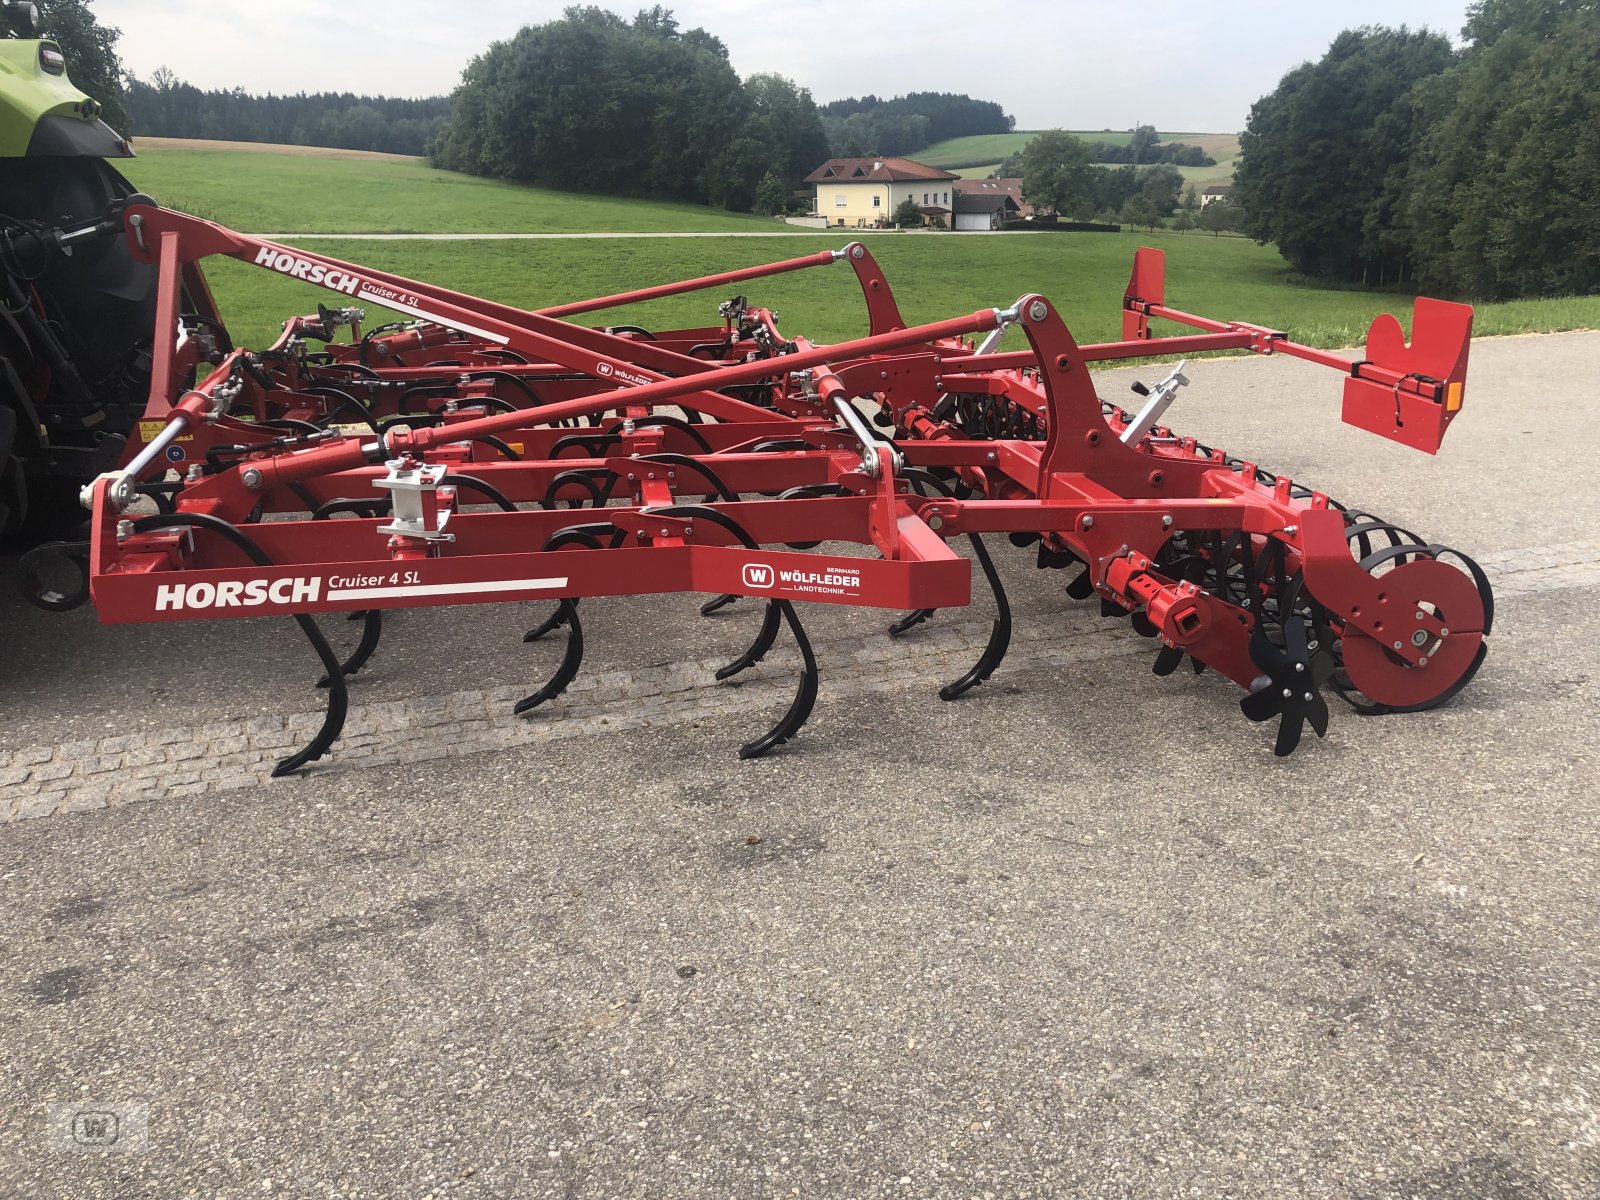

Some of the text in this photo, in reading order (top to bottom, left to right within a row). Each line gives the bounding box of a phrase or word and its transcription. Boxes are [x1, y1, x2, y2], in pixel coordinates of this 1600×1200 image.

[254, 246, 360, 295] HORSCH
[361, 281, 419, 307] Cruiser 4 SL
[328, 571, 421, 589] Cruiser 4 SL
[780, 570, 860, 587] WÖLFLEDER
[826, 567, 860, 575] BERNHARD
[155, 576, 322, 611] HORSCH
[794, 585, 845, 595] LANDTECHNIK
